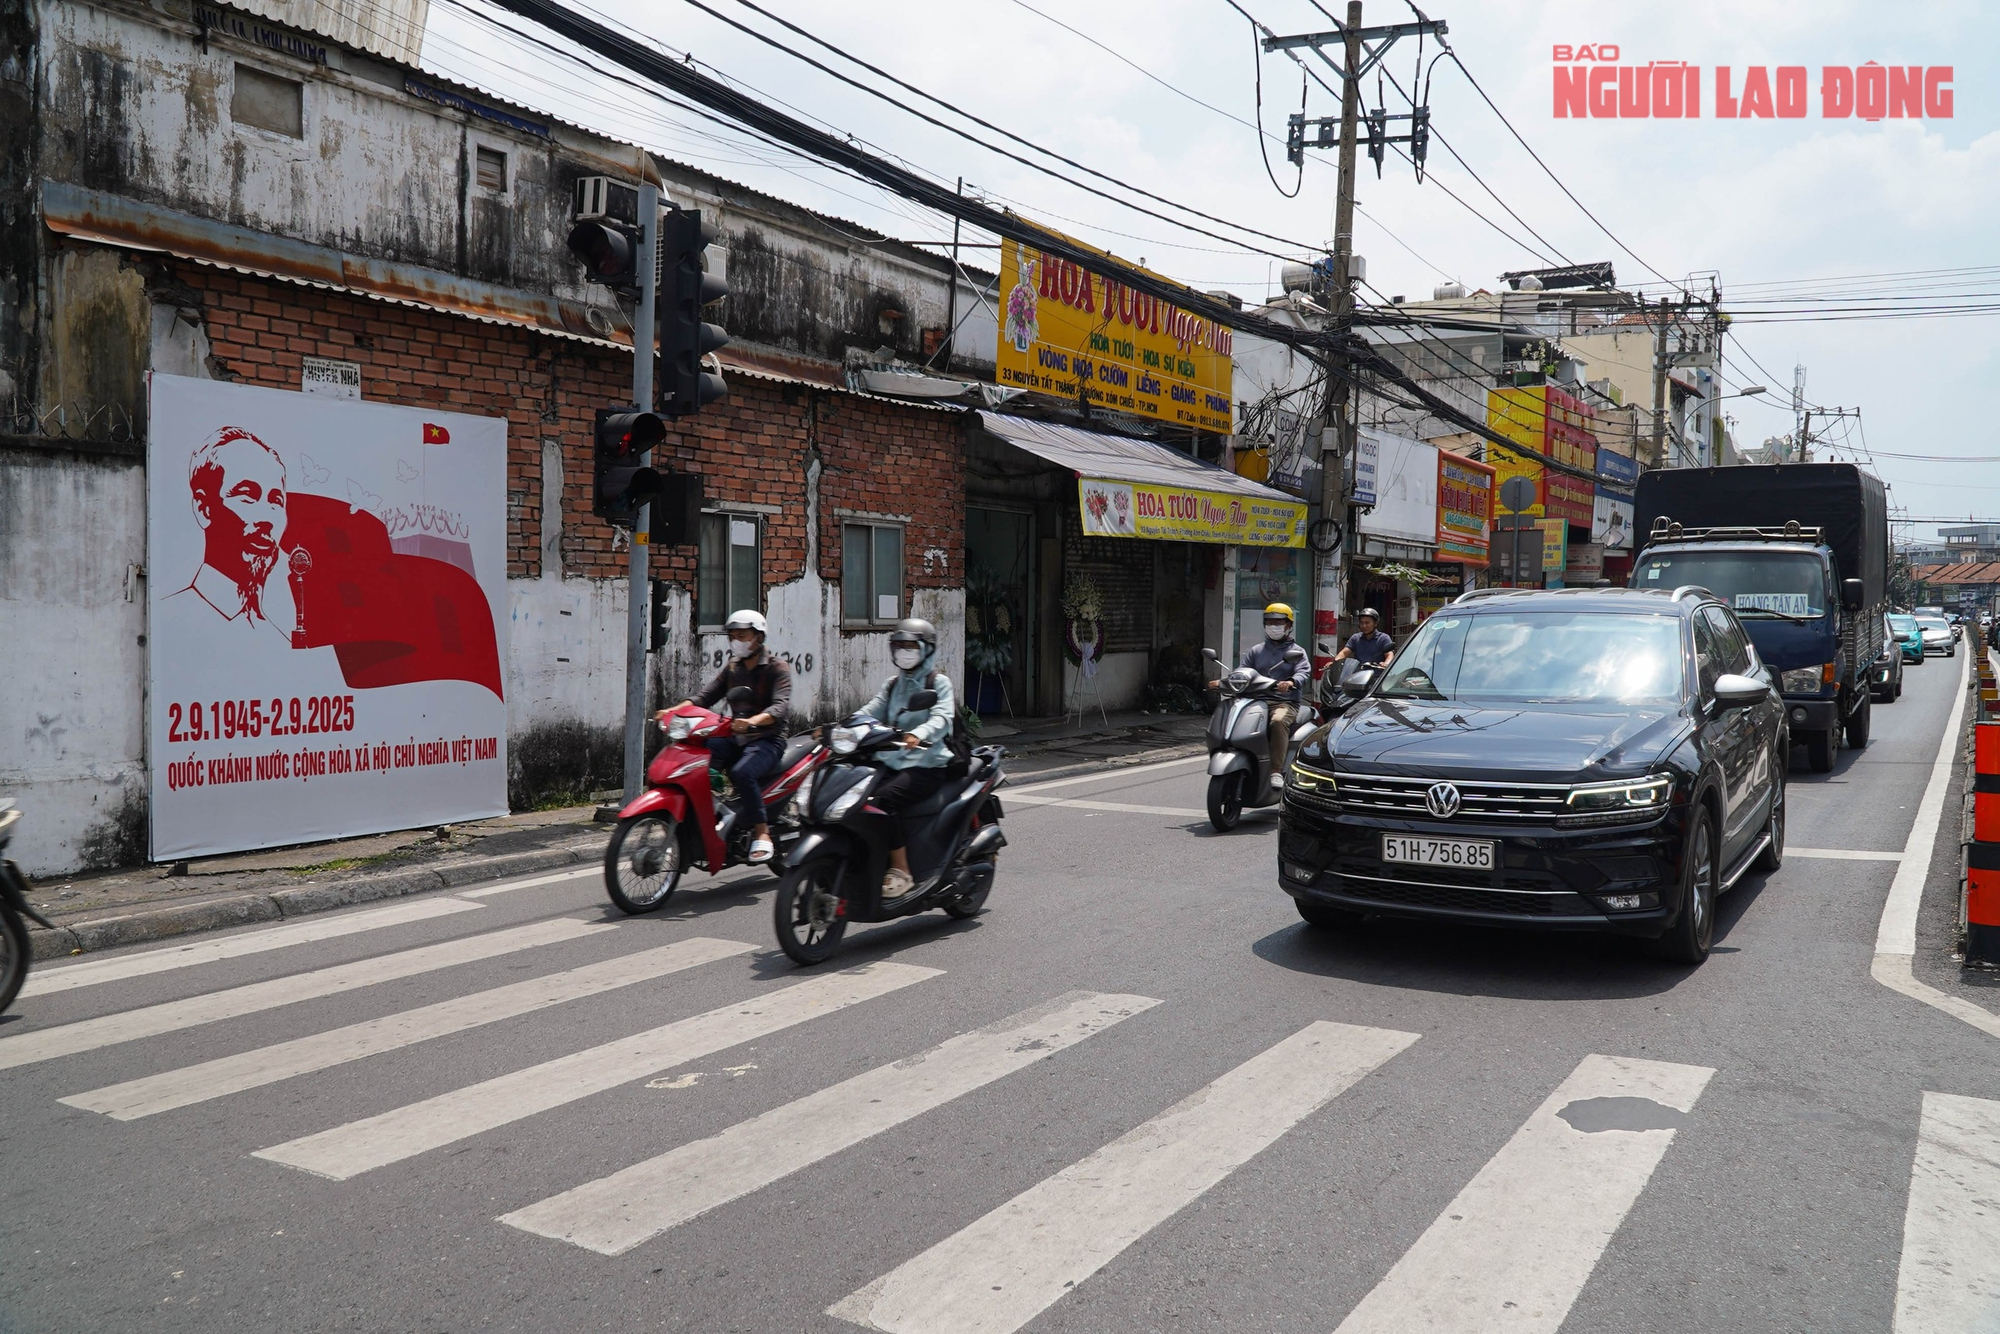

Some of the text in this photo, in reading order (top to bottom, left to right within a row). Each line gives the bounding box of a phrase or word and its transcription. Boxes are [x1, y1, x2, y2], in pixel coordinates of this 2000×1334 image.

[1002, 367, 1012, 381] 33
[1041, 374, 1053, 391] TẤT
[1038, 345, 1068, 373] VÒNG
[1073, 357, 1094, 380] HOA
[1099, 363, 1129, 388] CƯỜM
[1143, 348, 1160, 368] HOA
[1164, 355, 1176, 376] SỰ
[1178, 358, 1196, 381] KIỆN
[1136, 492, 1166, 517] HOA
[1168, 492, 1198, 521] TƯƠI
[1230, 500, 1248, 527] Thu
[1793, 596, 1806, 613] AN
[168, 695, 355, 743] 2.9.1945-2.9.2025
[168, 734, 498, 792] QUỐC KHÁNH NƯỚC CỘNG HÒA XÃ HỘI CHỦ NGHĨA VIỆT NAM
[1386, 838, 1491, 867] 51H-756.85
